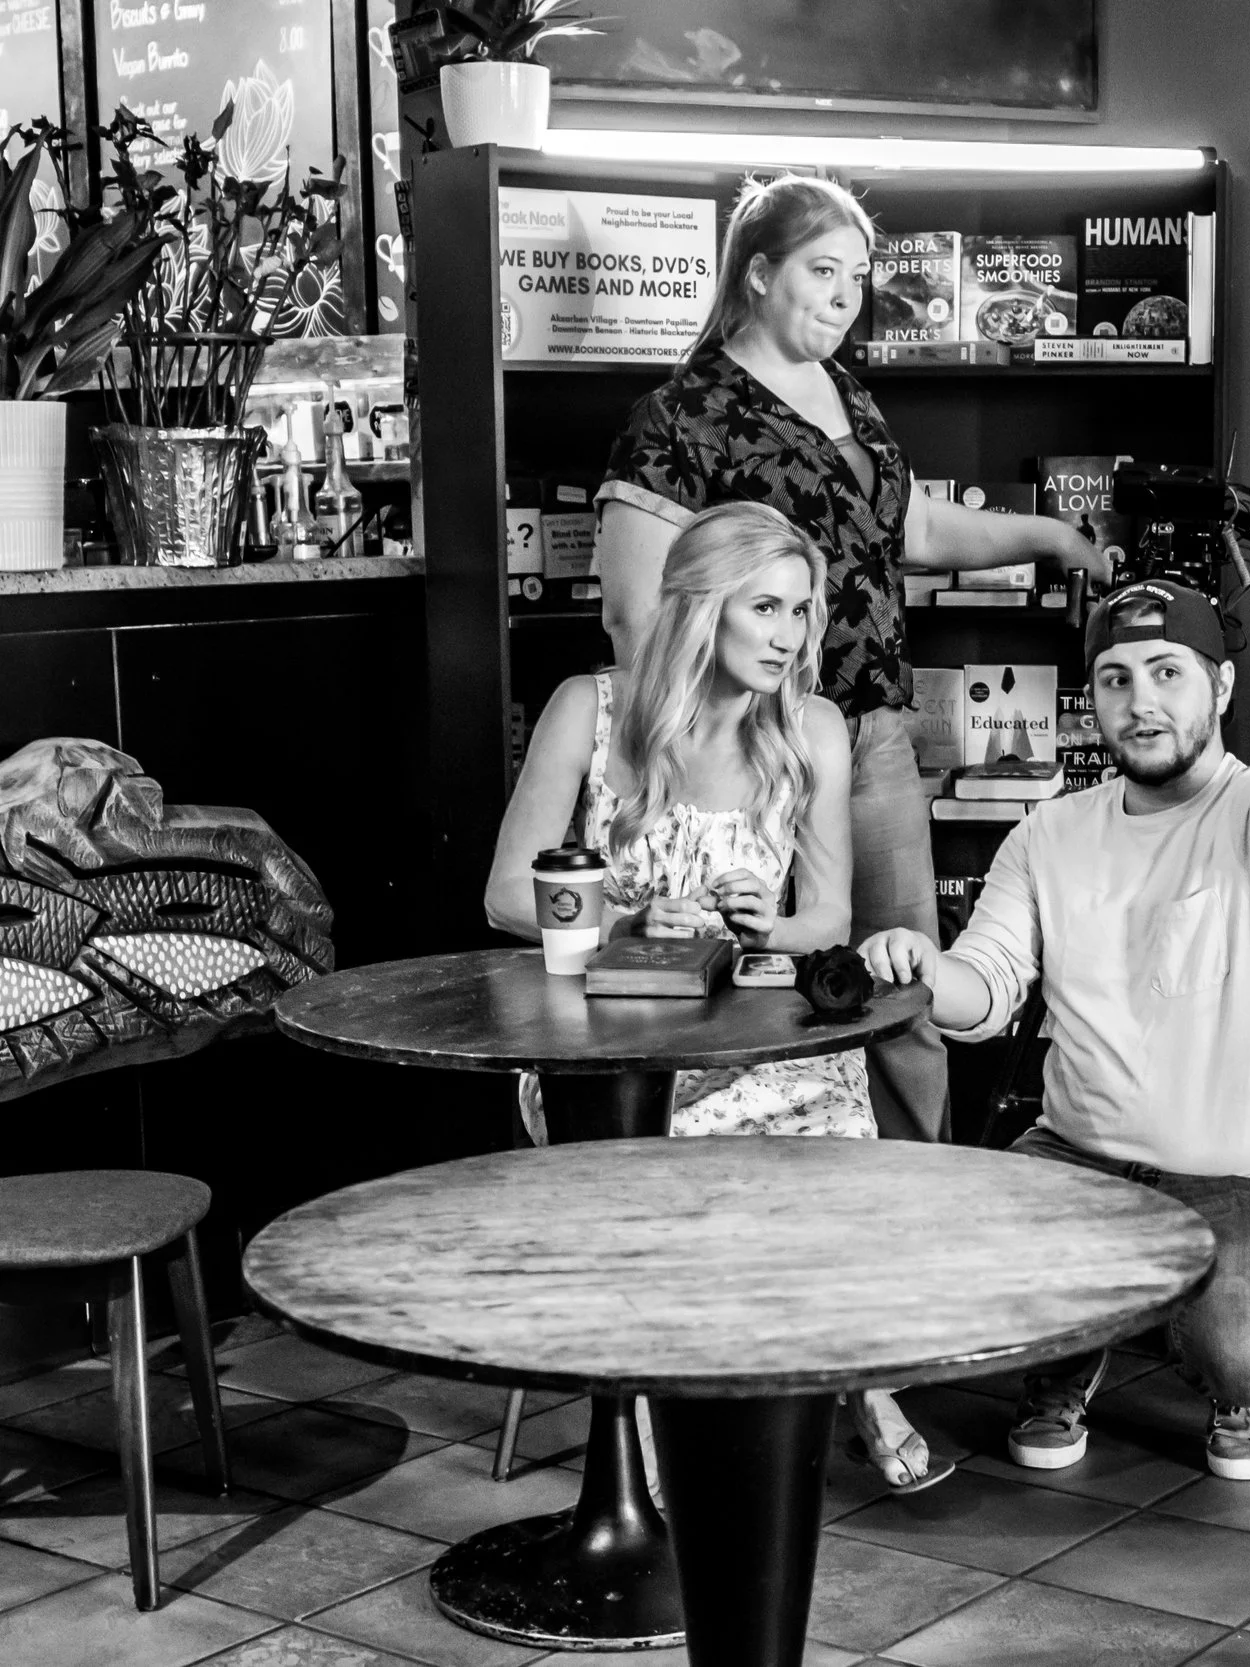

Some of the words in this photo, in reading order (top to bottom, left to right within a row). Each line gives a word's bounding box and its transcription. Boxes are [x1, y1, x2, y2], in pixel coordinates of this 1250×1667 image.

[147, 41, 188, 72] Burrito
[501, 210, 528, 225] ook
[529, 211, 565, 227] Nook
[606, 206, 629, 216] Proud
[631, 208, 640, 217] to
[641, 208, 652, 217] be
[653, 211, 671, 221] your
[672, 210, 694, 220] Local
[601, 217, 658, 229] Neighborhood
[659, 220, 698, 231] Bookstore
[888, 239, 938, 254] NORA
[500, 249, 526, 267] WE
[533, 250, 570, 270] BUY
[576, 252, 646, 275] BOOKS,
[652, 256, 710, 278] DVD'S,
[873, 259, 952, 274] ROBERTS
[976, 253, 1063, 268] SUPERFOOD
[976, 269, 1061, 284] SMOOTHIES
[518, 275, 590, 295] GAMES
[595, 278, 634, 297] AND
[639, 280, 697, 299] MORE!
[550, 314, 588, 324] Aksarben
[589, 315, 618, 326] Village
[624, 316, 664, 326] Downtown
[665, 318, 698, 329] Papillion
[551, 324, 593, 334] Downtown
[594, 326, 623, 335] Benson
[629, 327, 658, 336] Historic
[885, 329, 941, 341] RIVER'S
[1042, 342, 1074, 350] STEVEN
[1042, 351, 1074, 359] PINKER
[1127, 351, 1149, 359] NOW
[1043, 474, 1115, 492] ATOMI
[1058, 494, 1112, 512] LOVE
[1060, 696, 1095, 710] THE
[970, 715, 1049, 730] Educated
[1056, 732, 1083, 747] ON
[1065, 777, 1100, 787] AULA
